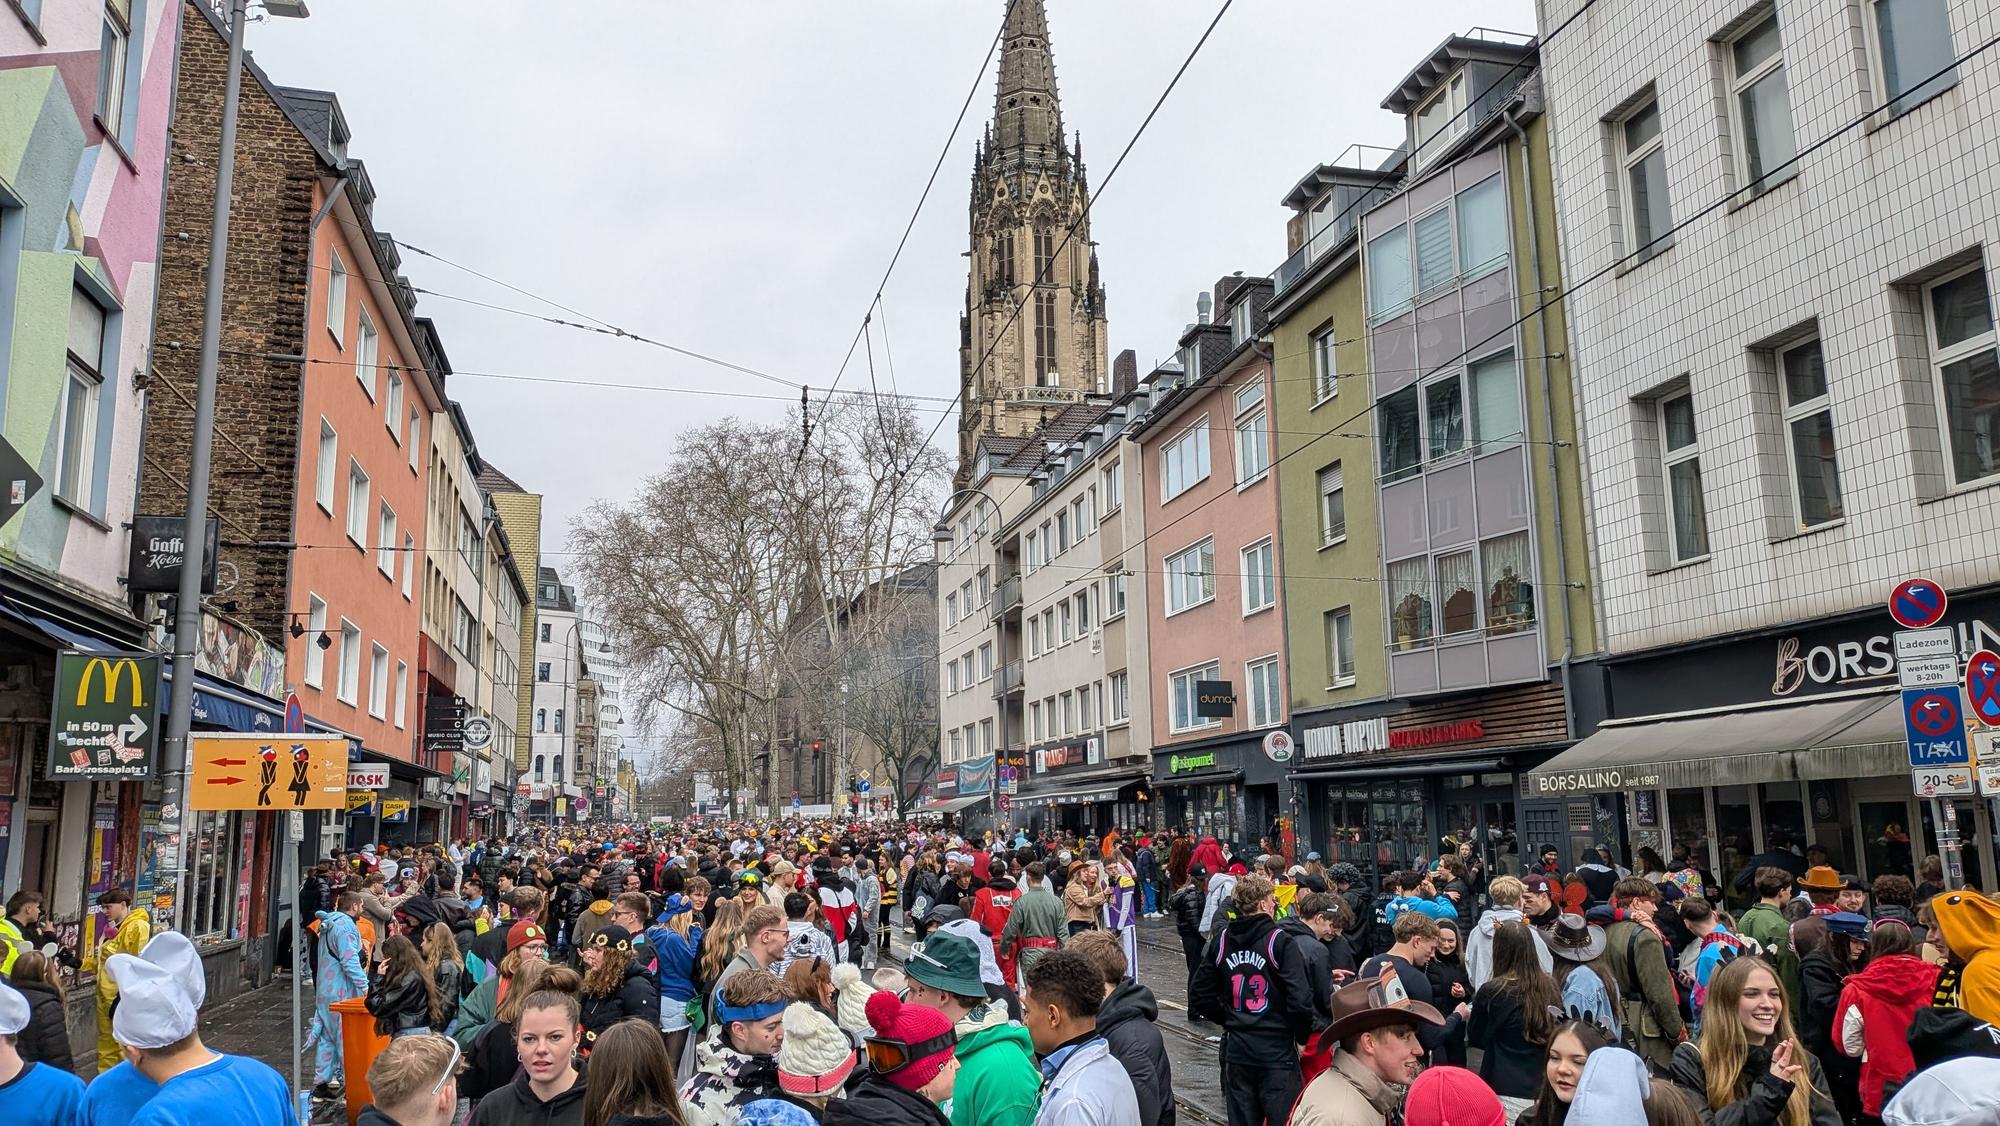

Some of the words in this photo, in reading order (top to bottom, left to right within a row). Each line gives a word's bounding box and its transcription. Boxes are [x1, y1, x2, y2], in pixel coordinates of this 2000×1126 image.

[149, 537, 184, 553] Gaff
[146, 554, 183, 569] Kölsc
[1899, 637, 1949, 650] Ladezone
[1772, 619, 2000, 695] BORSIN
[1906, 662, 1951, 675] werktags
[1916, 672, 1943, 682] 8-20h
[1200, 693, 1232, 704] duma
[66, 721, 80, 731] in
[82, 722, 100, 731] 50
[75, 736, 111, 746] echts
[1304, 724, 1343, 759] NONNA
[1344, 717, 1389, 753] NAPOLI
[1913, 740, 1963, 759] TAXI
[997, 757, 1025, 766] MNGO
[142, 765, 148, 773] 1
[1540, 771, 1621, 792] BORSALINO
[1625, 777, 1640, 787] seit
[1640, 775, 1660, 786] 1987
[1225, 949, 1267, 971] ADEBAYO
[1231, 973, 1269, 1013] 13
